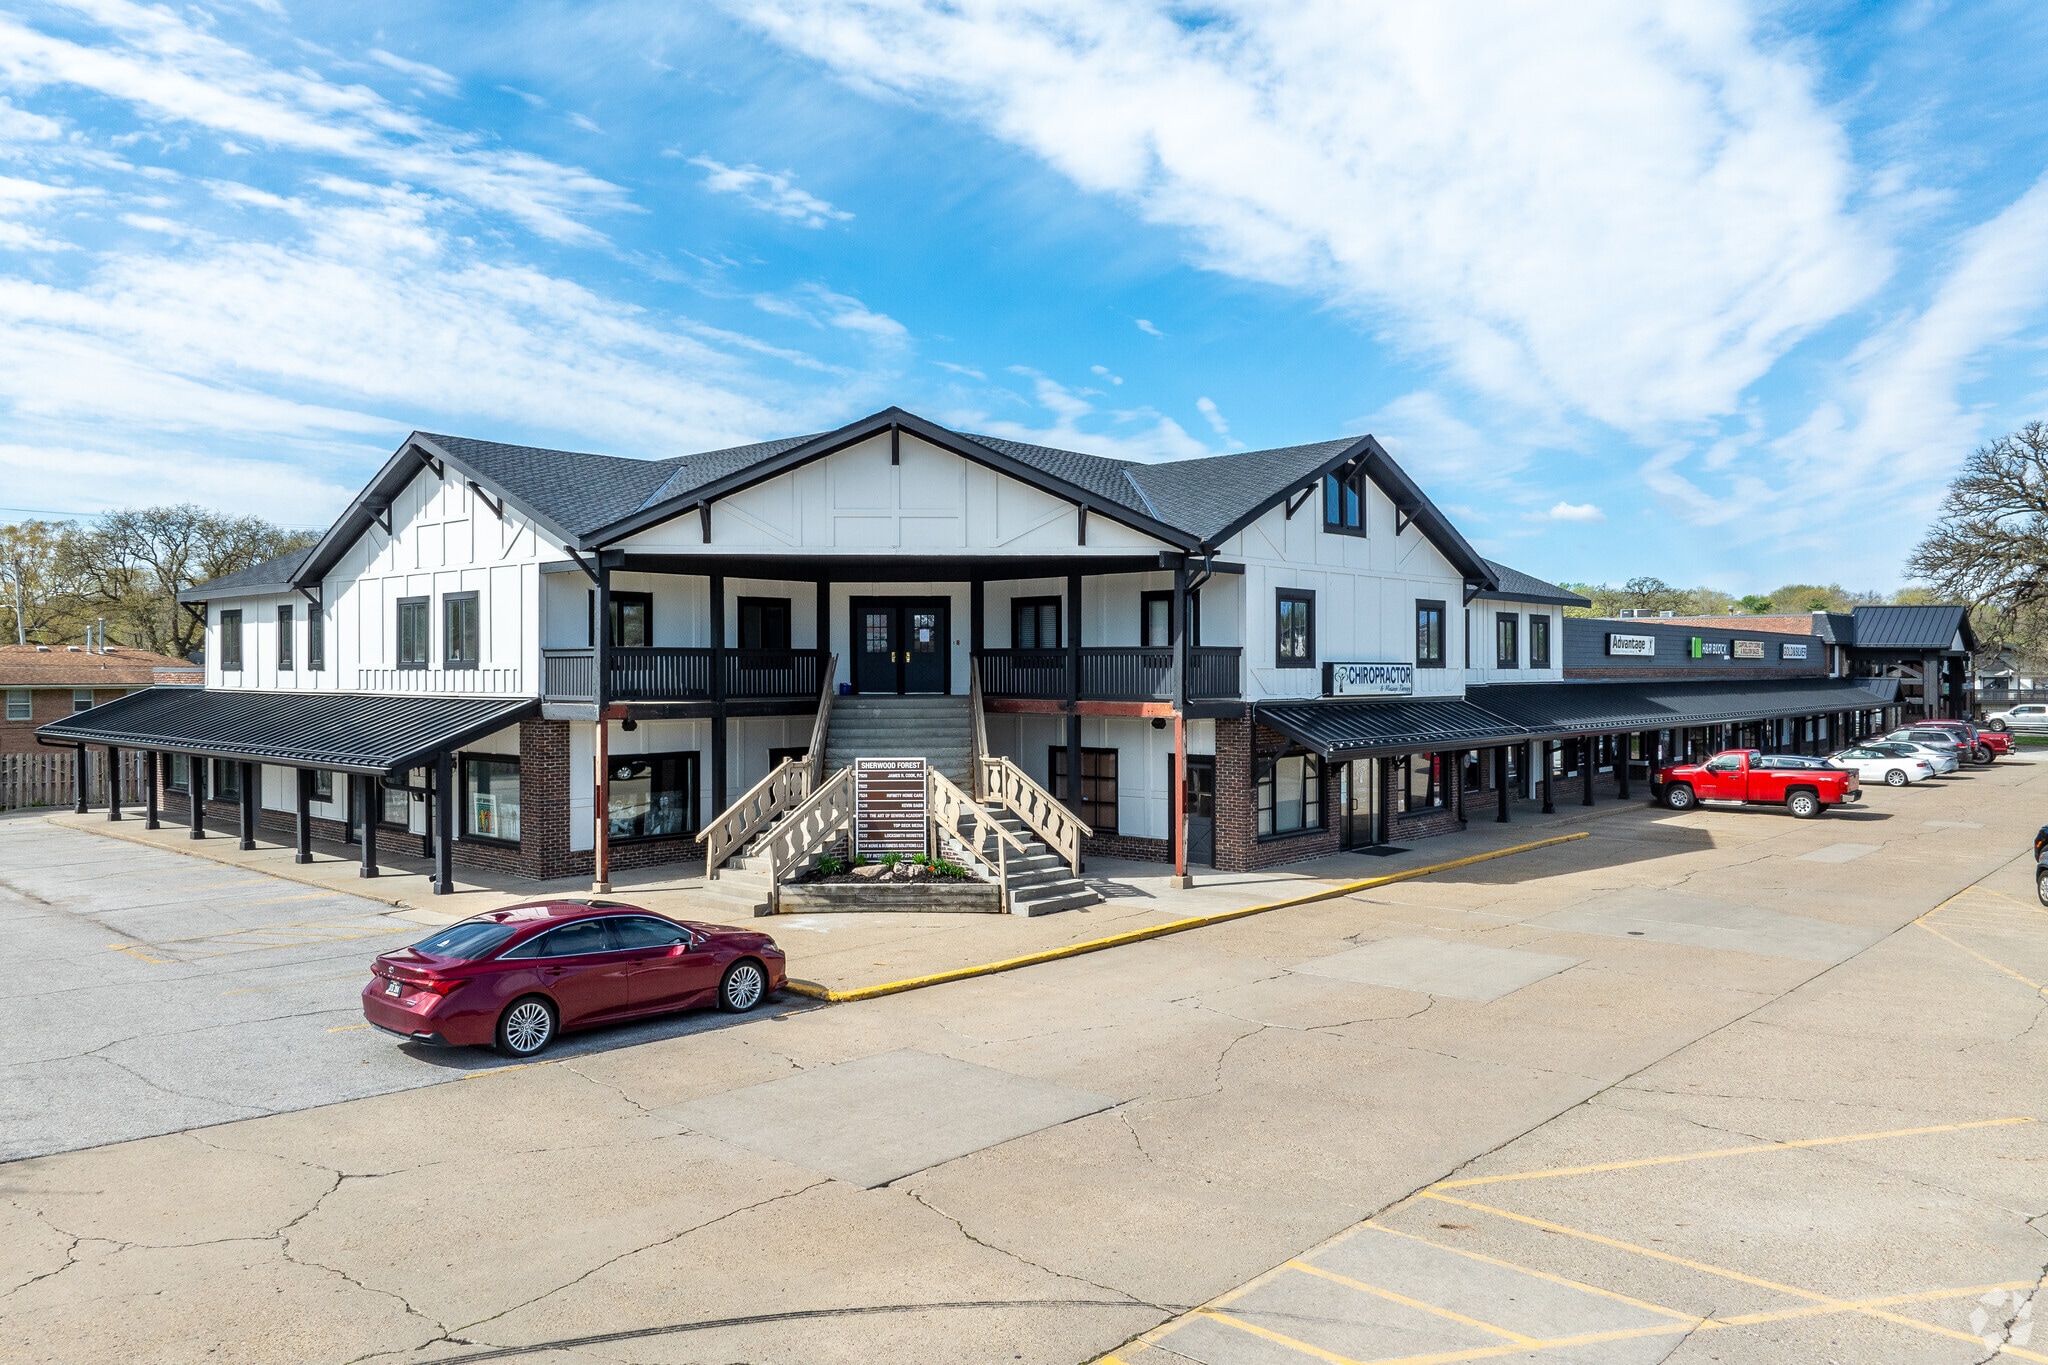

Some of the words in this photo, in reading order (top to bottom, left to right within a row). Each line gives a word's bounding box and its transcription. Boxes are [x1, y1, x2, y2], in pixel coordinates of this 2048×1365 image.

[1612, 635, 1645, 652] Advantage
[1702, 643, 1712, 654] H&R
[1713, 643, 1727, 654] BLOCK
[1348, 666, 1410, 684] CHIROPRACTOR
